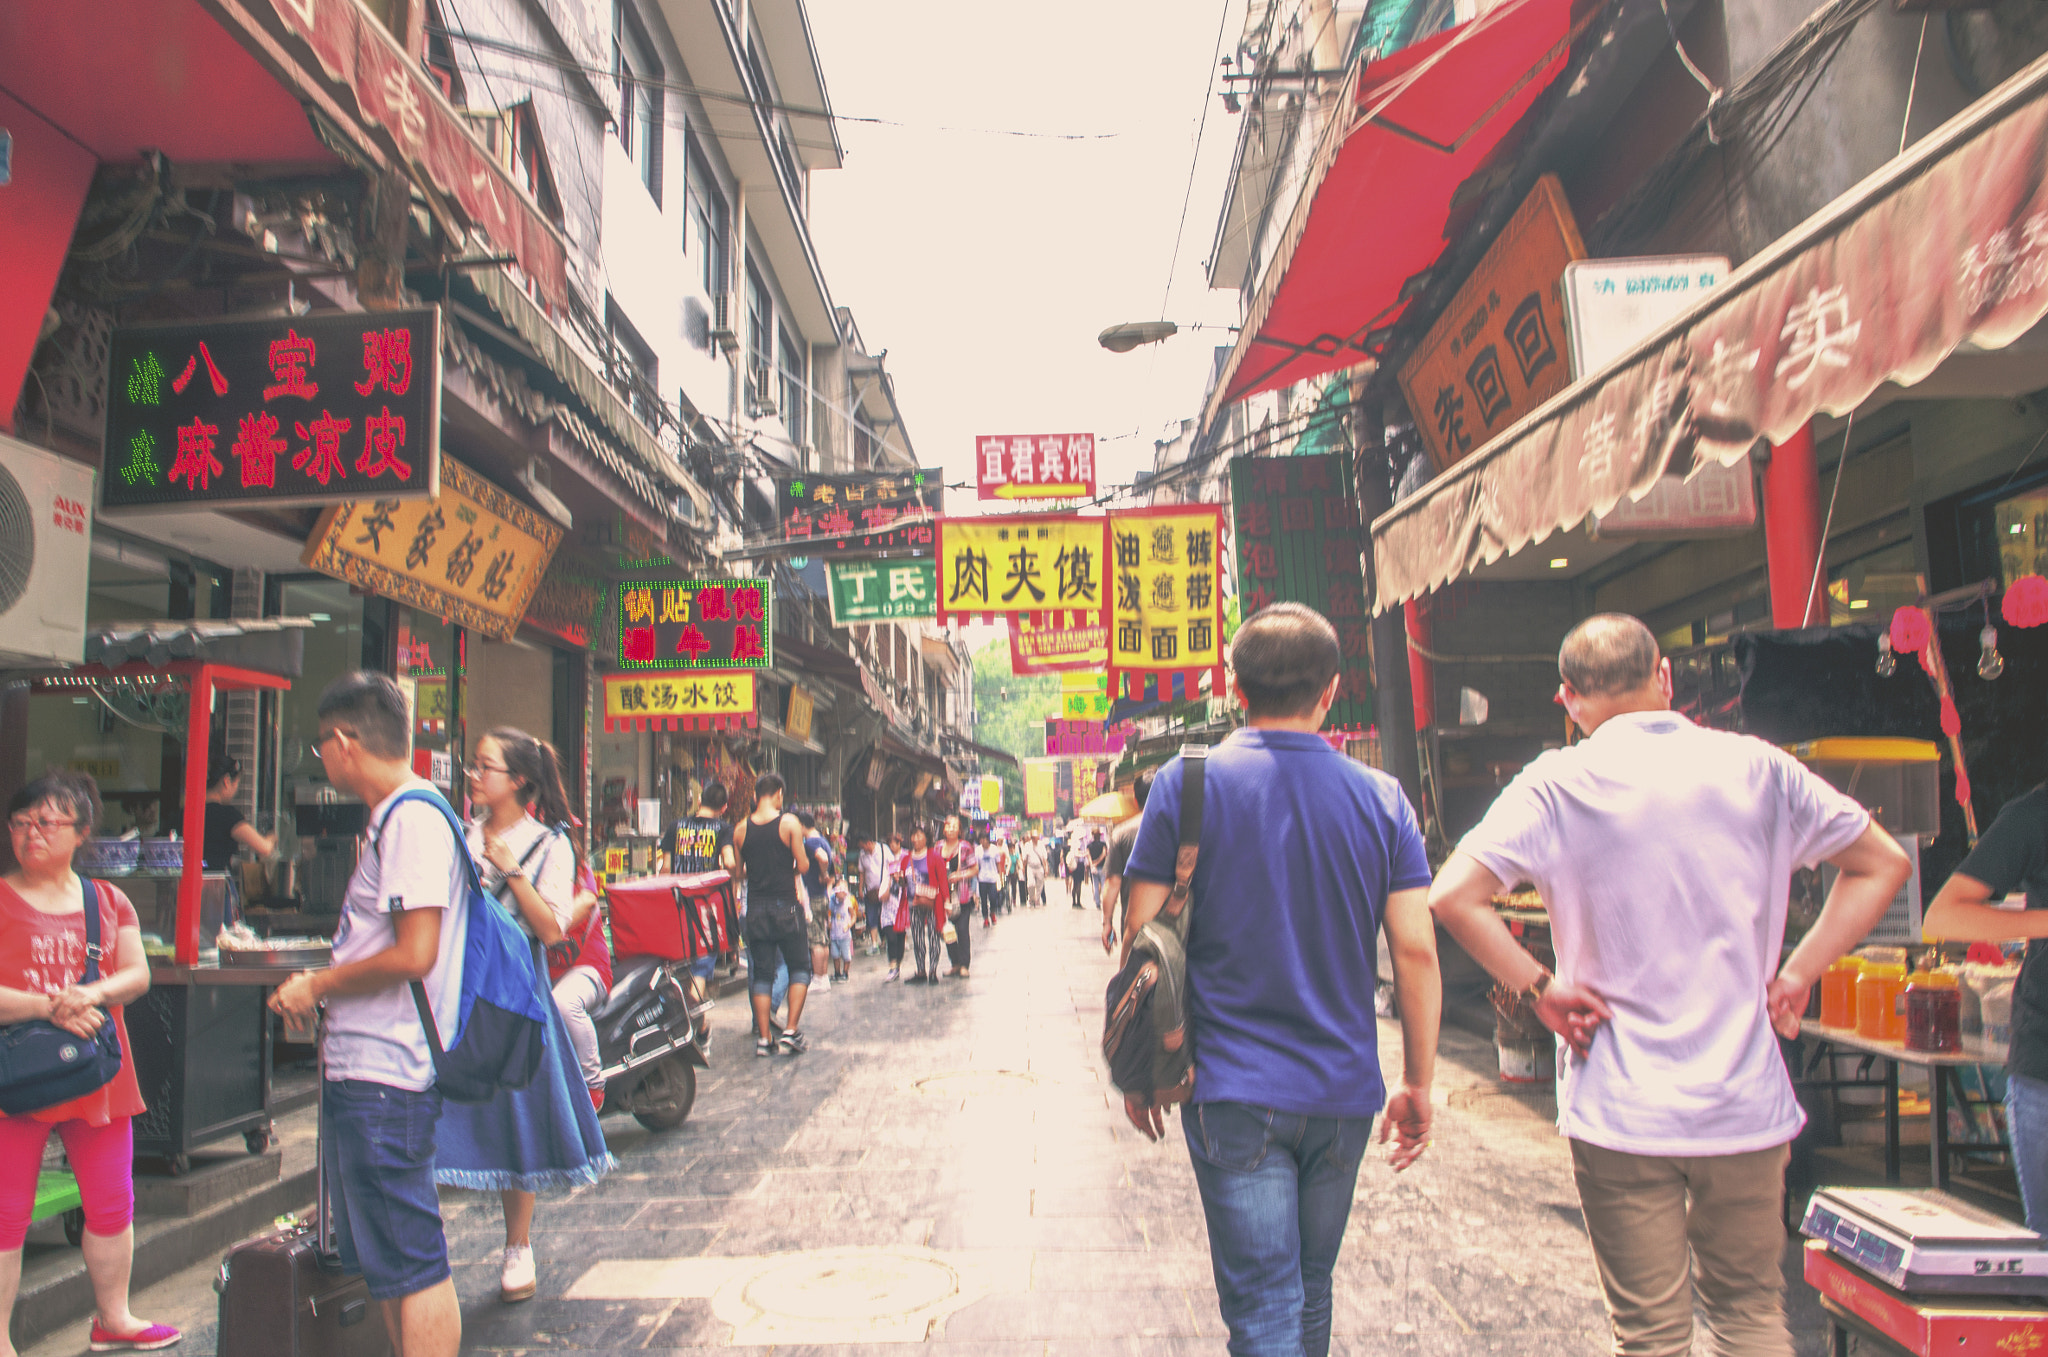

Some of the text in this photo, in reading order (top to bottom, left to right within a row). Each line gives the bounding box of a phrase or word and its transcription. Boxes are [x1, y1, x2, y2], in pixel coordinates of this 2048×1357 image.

[172, 328, 412, 402] 八宝粥
[1434, 290, 1557, 453] 老回回
[981, 436, 1093, 484] 宜君宾馆
[838, 566, 937, 604] 丁民
[949, 545, 1097, 604] 肉夹馍
[1117, 530, 1142, 653] 油泼面
[1186, 529, 1213, 652] 裤带面
[620, 681, 739, 711] 酸汤水饺
